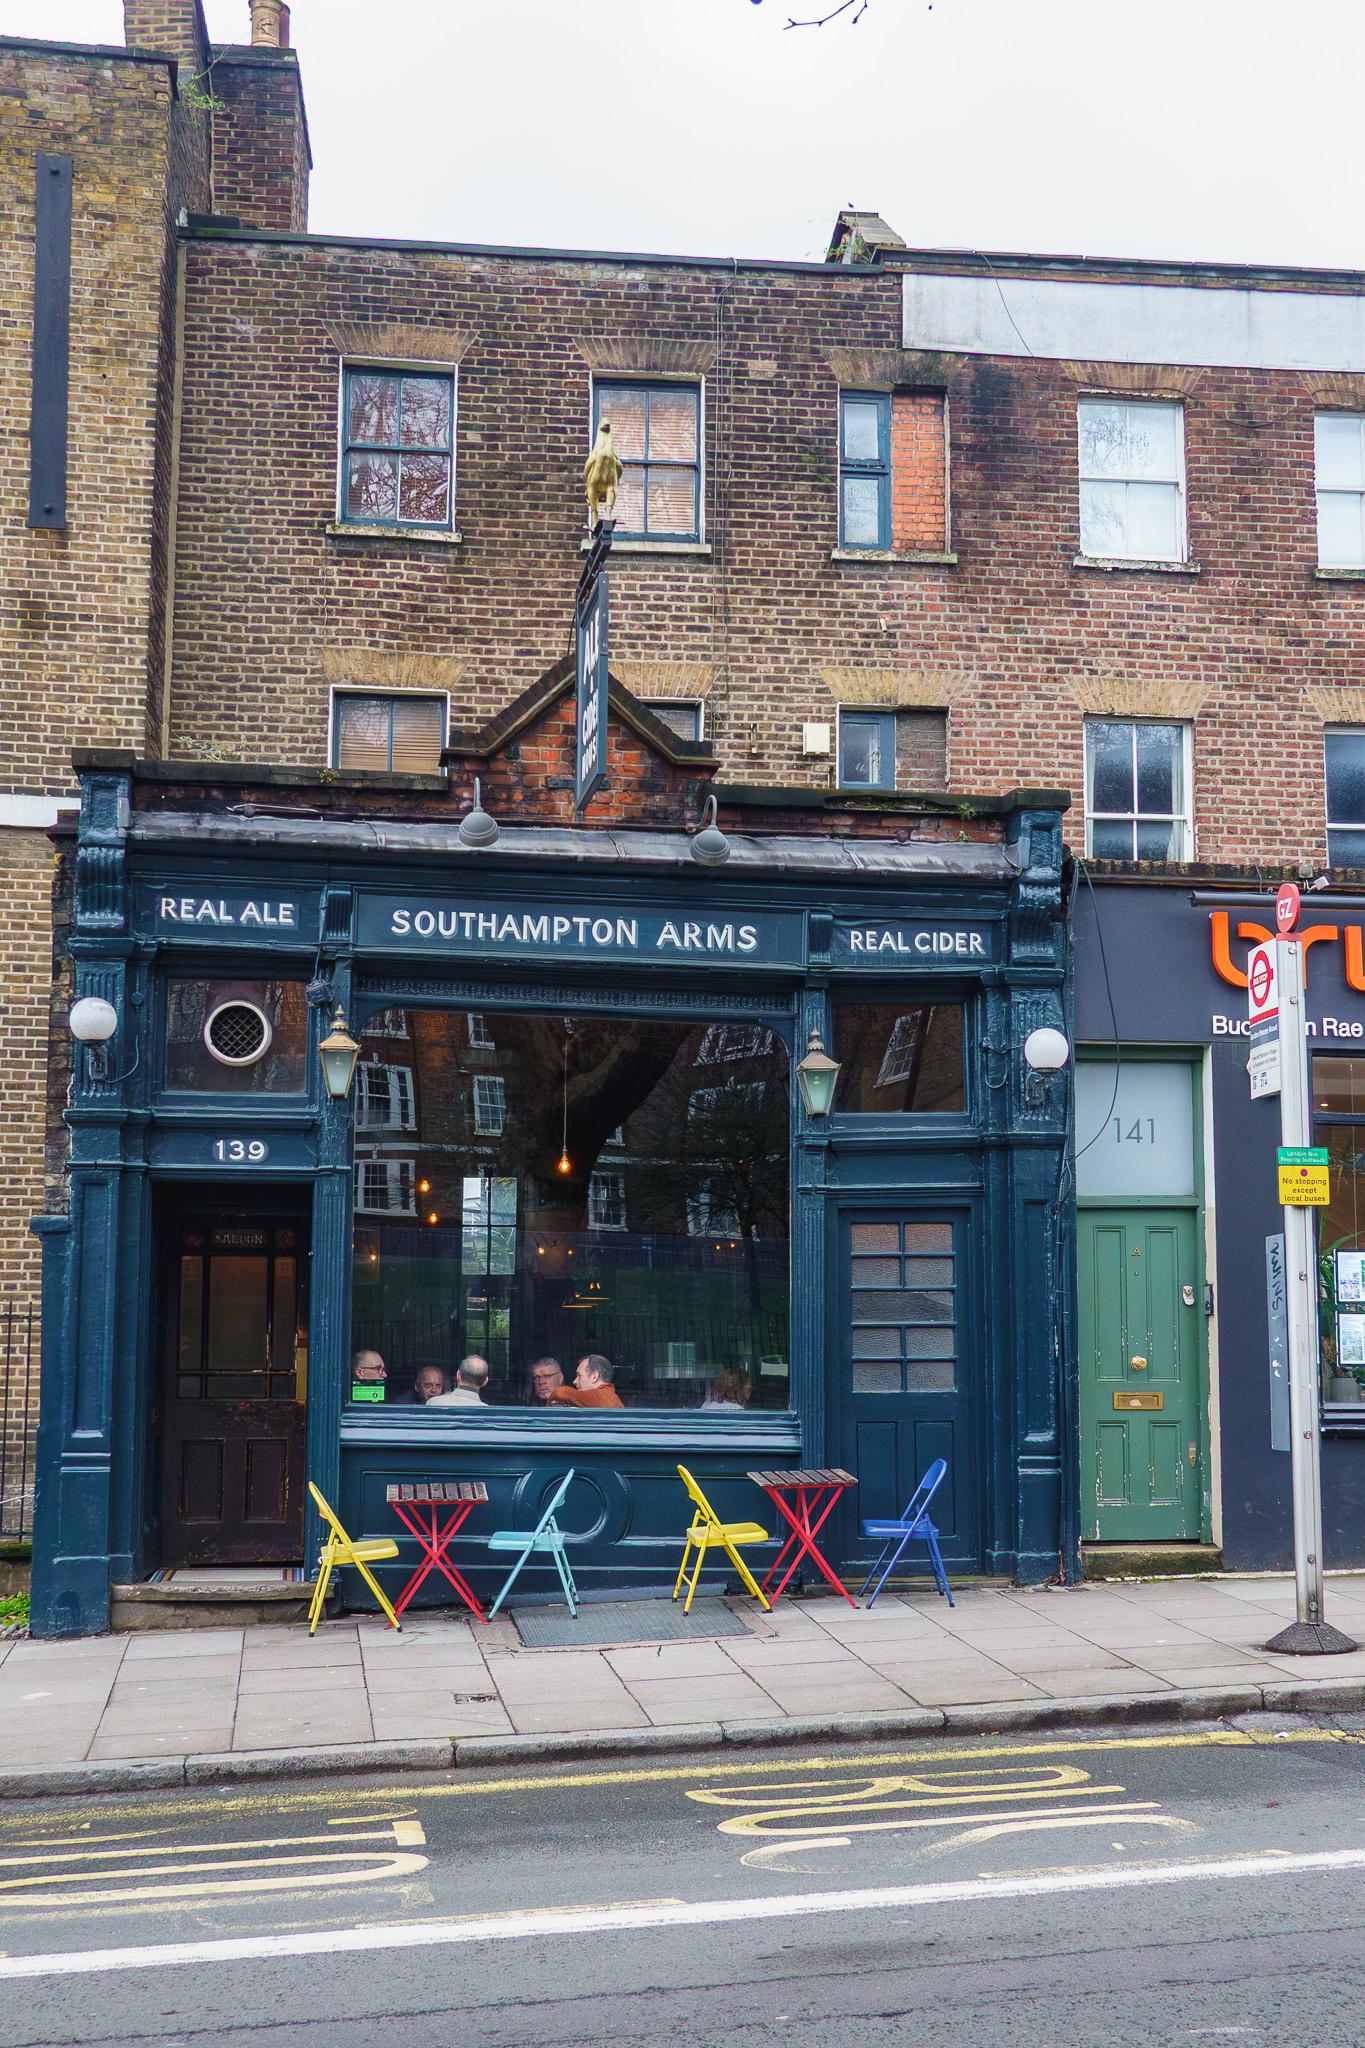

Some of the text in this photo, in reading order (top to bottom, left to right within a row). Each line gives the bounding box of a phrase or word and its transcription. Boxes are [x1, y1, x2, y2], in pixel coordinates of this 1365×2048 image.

[160, 897, 295, 926] REAL ALE
[1277, 897, 1294, 921] GZ
[390, 909, 758, 953] SOUTHAMPTON ARMS
[850, 930, 986, 955] REAL CIDER
[1322, 1017, 1364, 1039] Rae
[1113, 1117, 1155, 1144] 141
[216, 1139, 265, 1160] 139
[1282, 1177, 1327, 1186] No stopping
[216, 1233, 264, 1246] SALOON
[1131, 1246, 1142, 1257] A
[685, 1765, 1200, 1874] BUS
